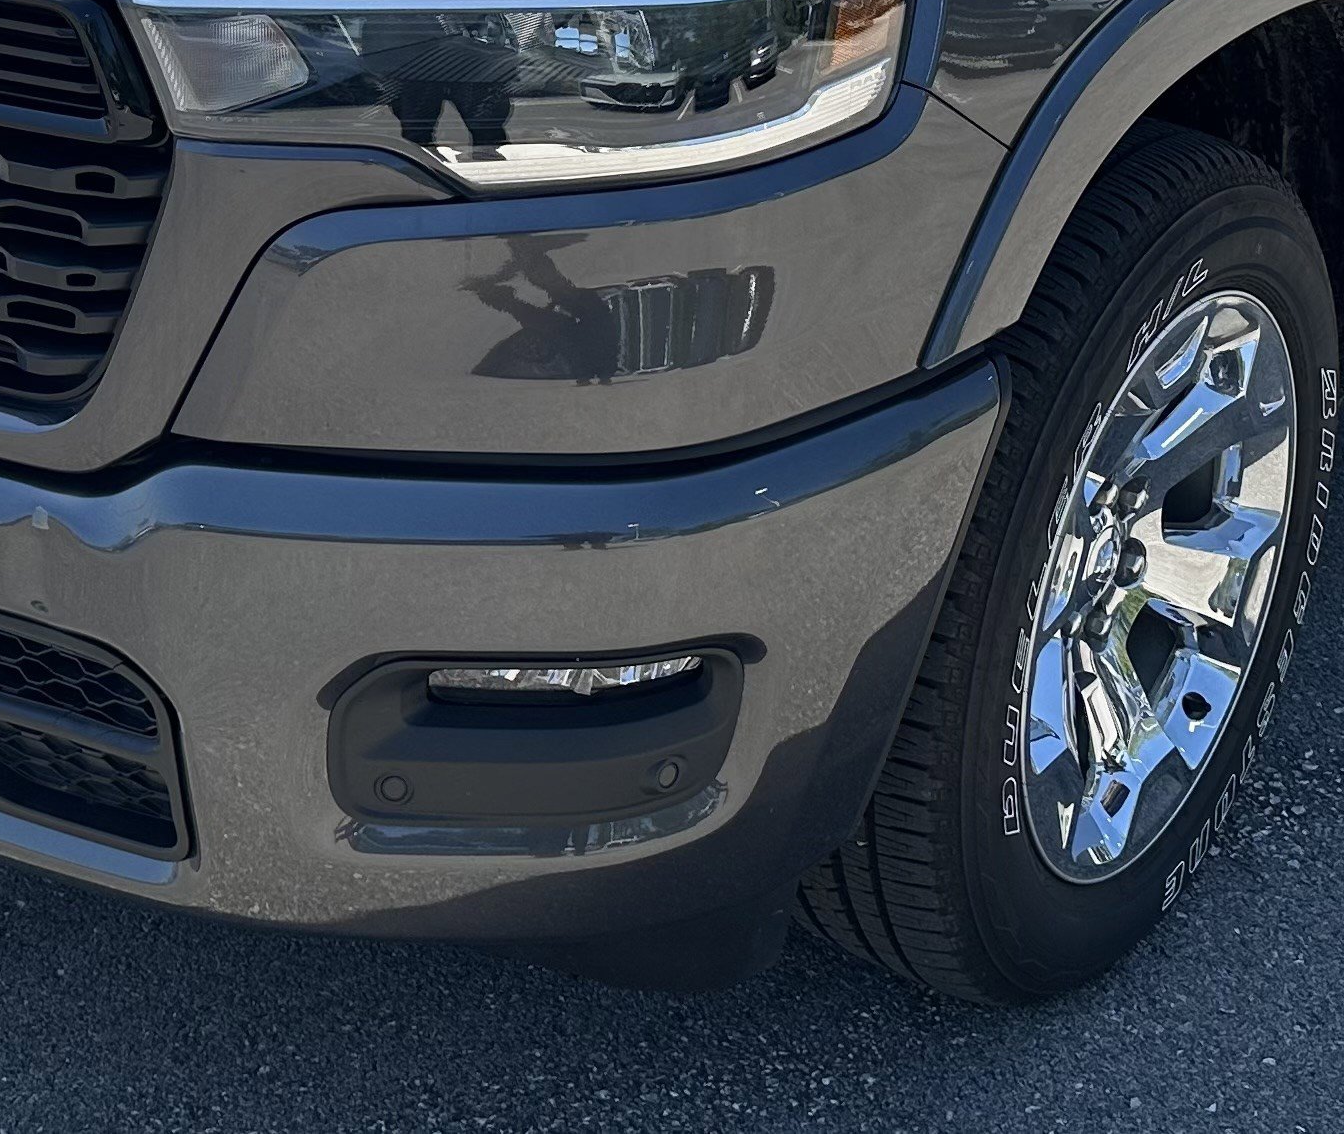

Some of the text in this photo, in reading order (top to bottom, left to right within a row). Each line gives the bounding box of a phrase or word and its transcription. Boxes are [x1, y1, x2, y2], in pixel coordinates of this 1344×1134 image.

[1002, 258, 1209, 835] DUELER H/L
[1162, 367, 1337, 911] BRIDGESTONE
